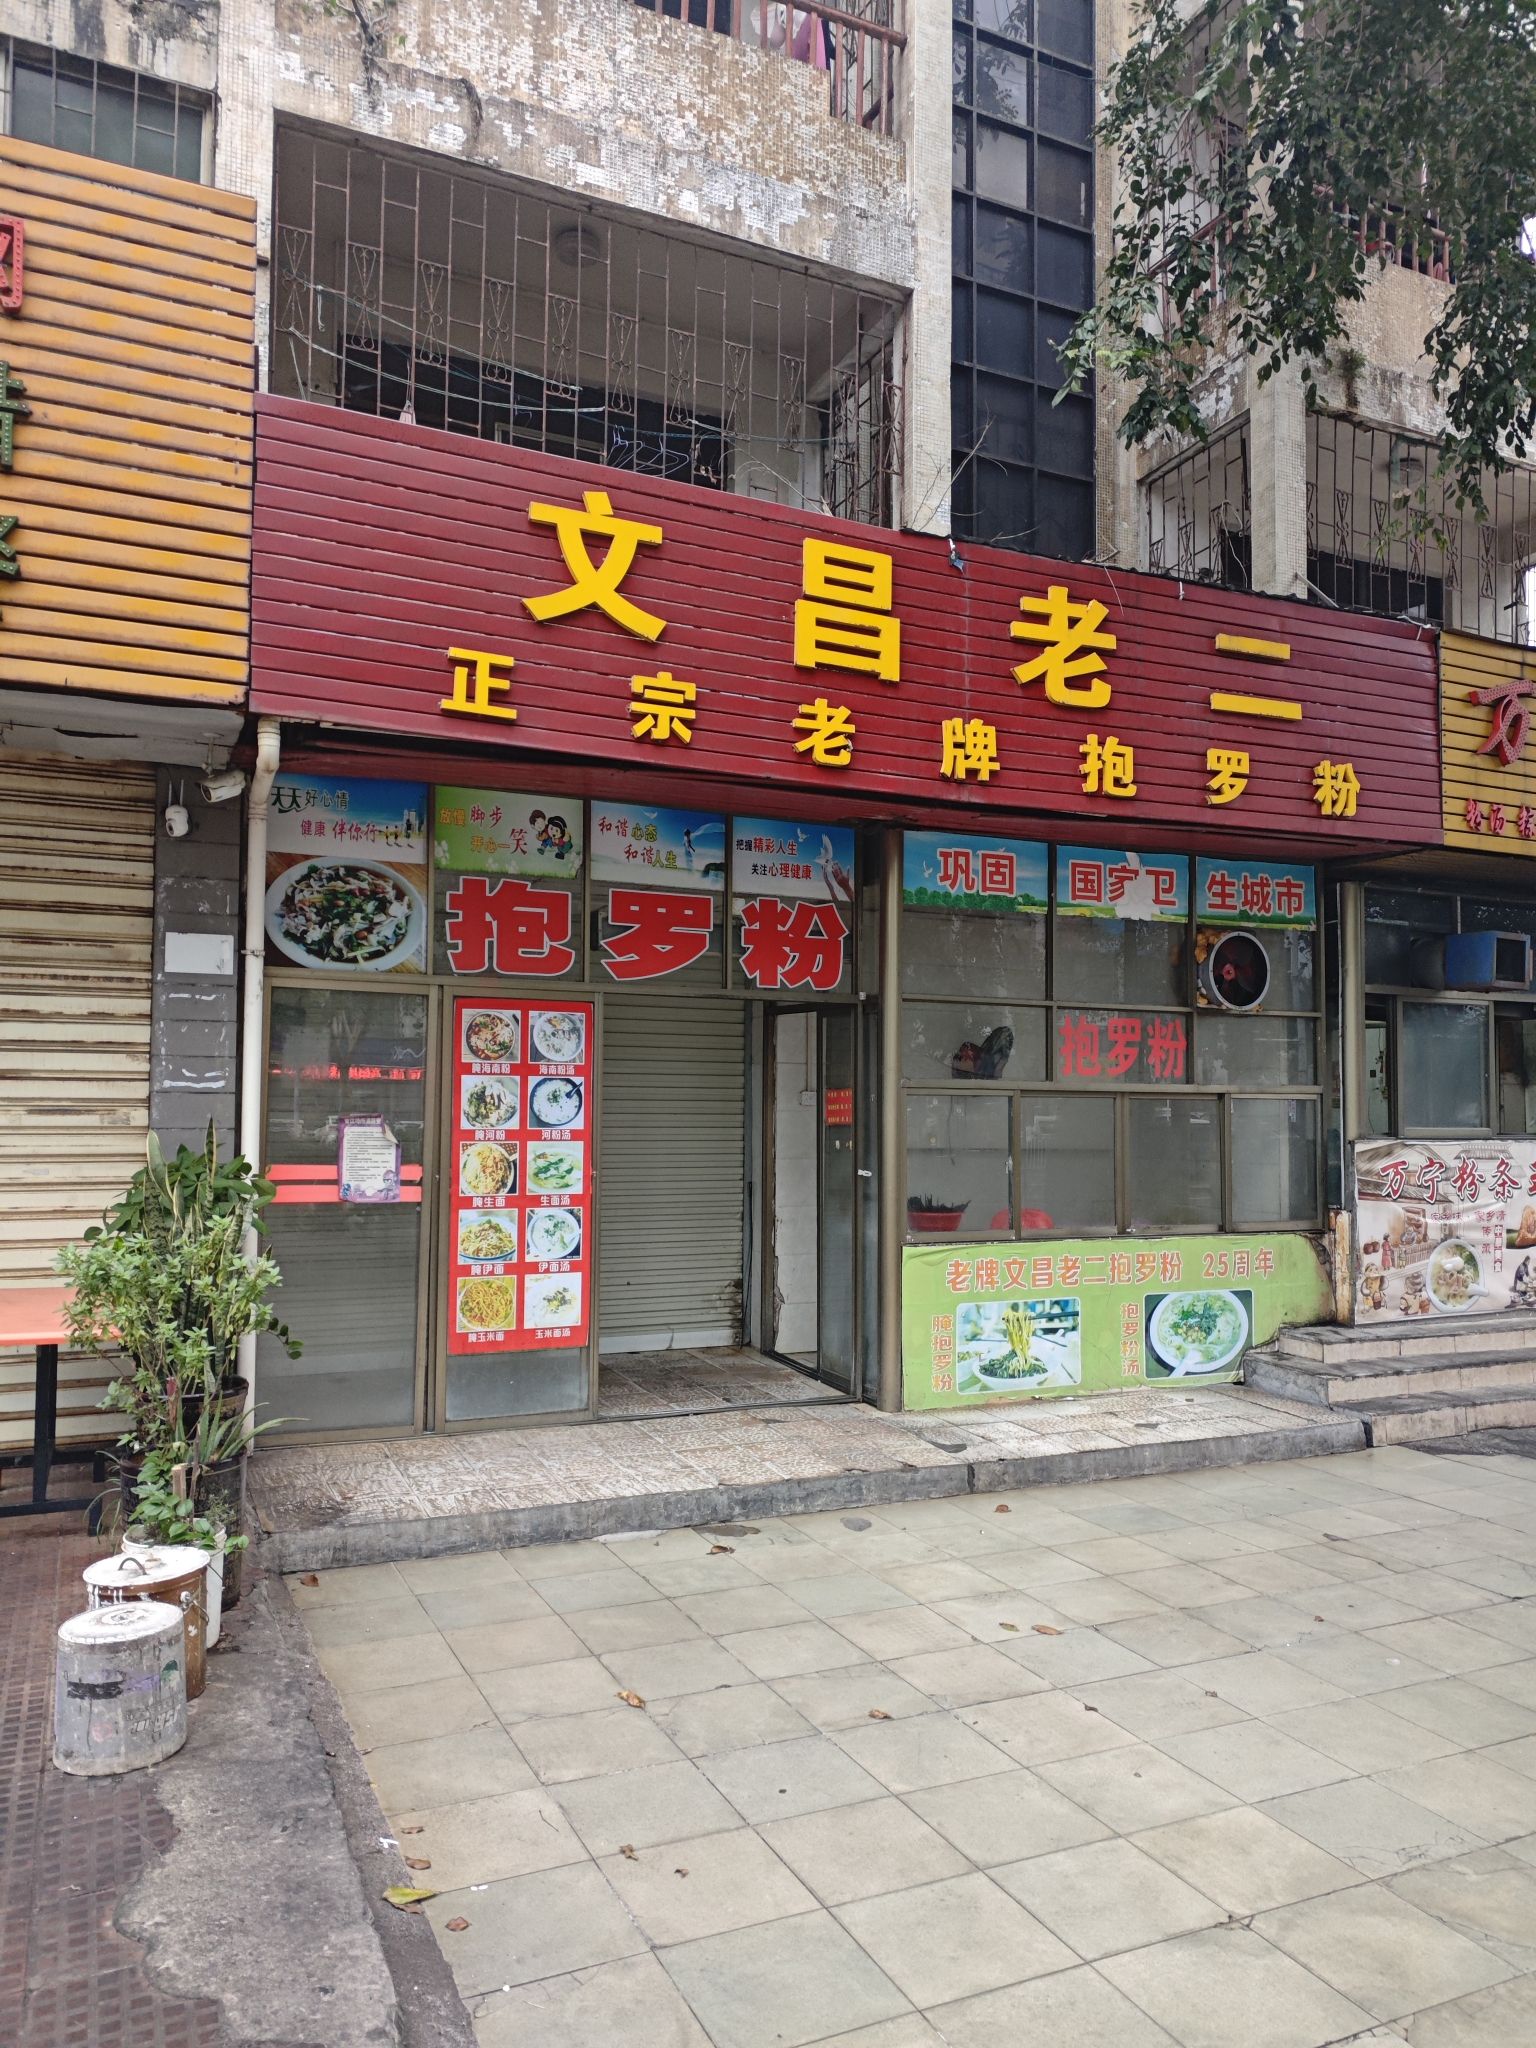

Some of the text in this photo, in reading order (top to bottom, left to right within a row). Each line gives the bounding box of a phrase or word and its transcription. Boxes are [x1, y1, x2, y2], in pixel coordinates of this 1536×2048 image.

[522, 491, 1303, 720] 文昌老二
[441, 648, 1362, 817] 正宗老牌抱罗粉
[271, 786, 349, 812] 天天好心情
[441, 804, 503, 829] 放慢脚步
[598, 815, 658, 842] 和谐心态
[301, 819, 379, 843] 健康伴你行
[471, 828, 528, 855] 开心一笑
[624, 846, 678, 870] 和谐人生
[735, 836, 798, 856] 把握精彩人生
[751, 862, 813, 881] 关注心理健康
[445, 875, 850, 990] 抱罗粉
[1058, 1014, 1188, 1078] 抱罗粉
[539, 1064, 575, 1075] 海南粉汤
[541, 1129, 571, 1140] 河粉汤
[1379, 1154, 1536, 1203] 万宁粉条
[540, 1194, 570, 1206] 生面汤
[538, 1261, 570, 1273] 伊面汤
[945, 1247, 1276, 1294] 老牌文昌老二抱罗粉 25周年
[535, 1328, 571, 1340] 玉米面汤
[1119, 1302, 1140, 1377] 抱罗粉汤
